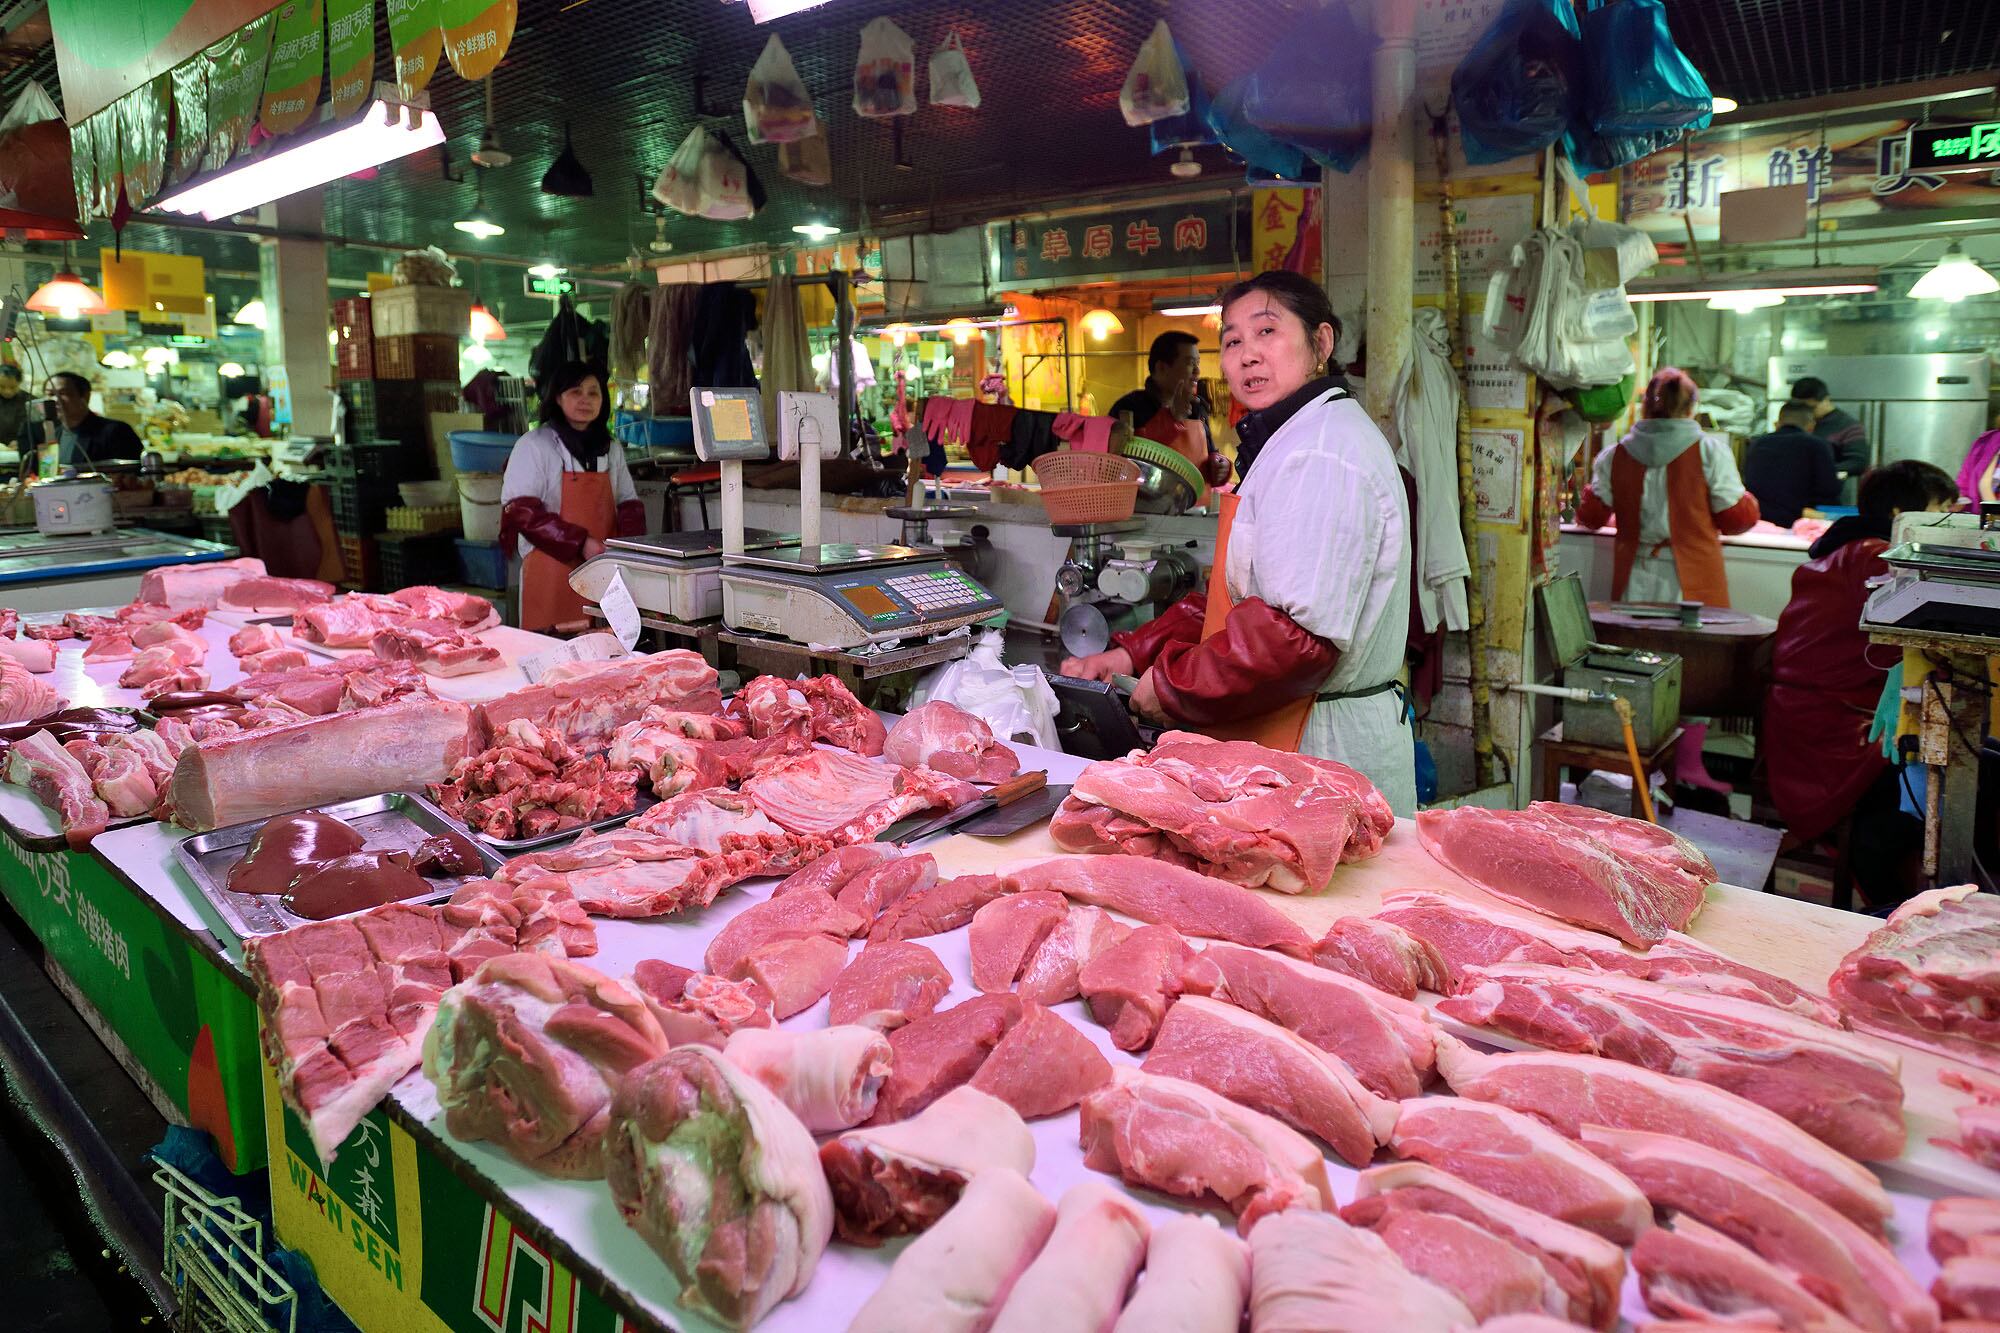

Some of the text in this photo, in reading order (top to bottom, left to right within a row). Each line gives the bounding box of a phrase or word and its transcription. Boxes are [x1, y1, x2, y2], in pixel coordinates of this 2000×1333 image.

[456, 29, 497, 56] 冷鲜猪肉
[269, 98, 305, 116] 冷鲜猪肉
[1664, 134, 2000, 214] 新鲜贝
[1041, 214, 1208, 263] 草原牛肉
[75, 887, 131, 981] 冷鲜猪肉
[350, 1117, 392, 1236] 万森
[286, 1151, 403, 1293] WAN SEN
